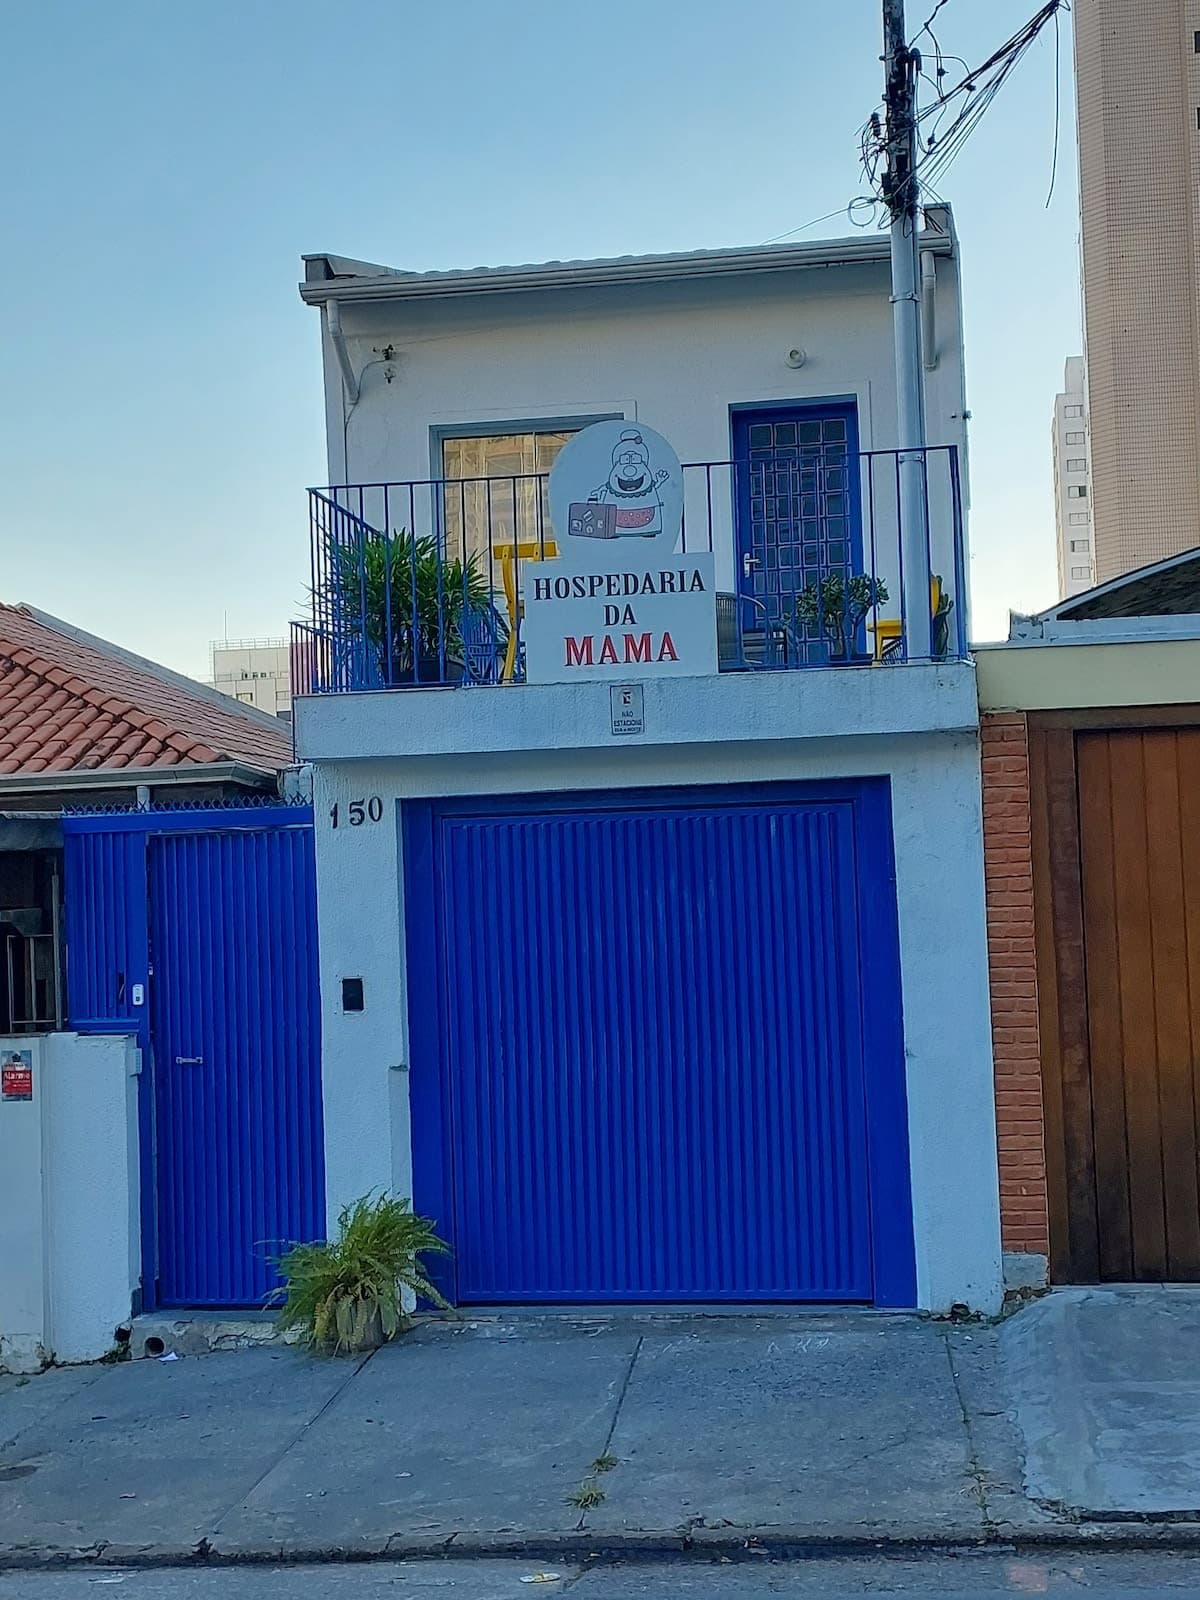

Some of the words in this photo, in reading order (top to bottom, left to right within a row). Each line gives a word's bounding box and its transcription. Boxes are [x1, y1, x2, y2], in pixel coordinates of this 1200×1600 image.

[533, 569, 706, 600] HOSPEDARIA
[603, 603, 637, 626] DA
[564, 631, 680, 666] MAMA
[330, 796, 383, 829] 150
